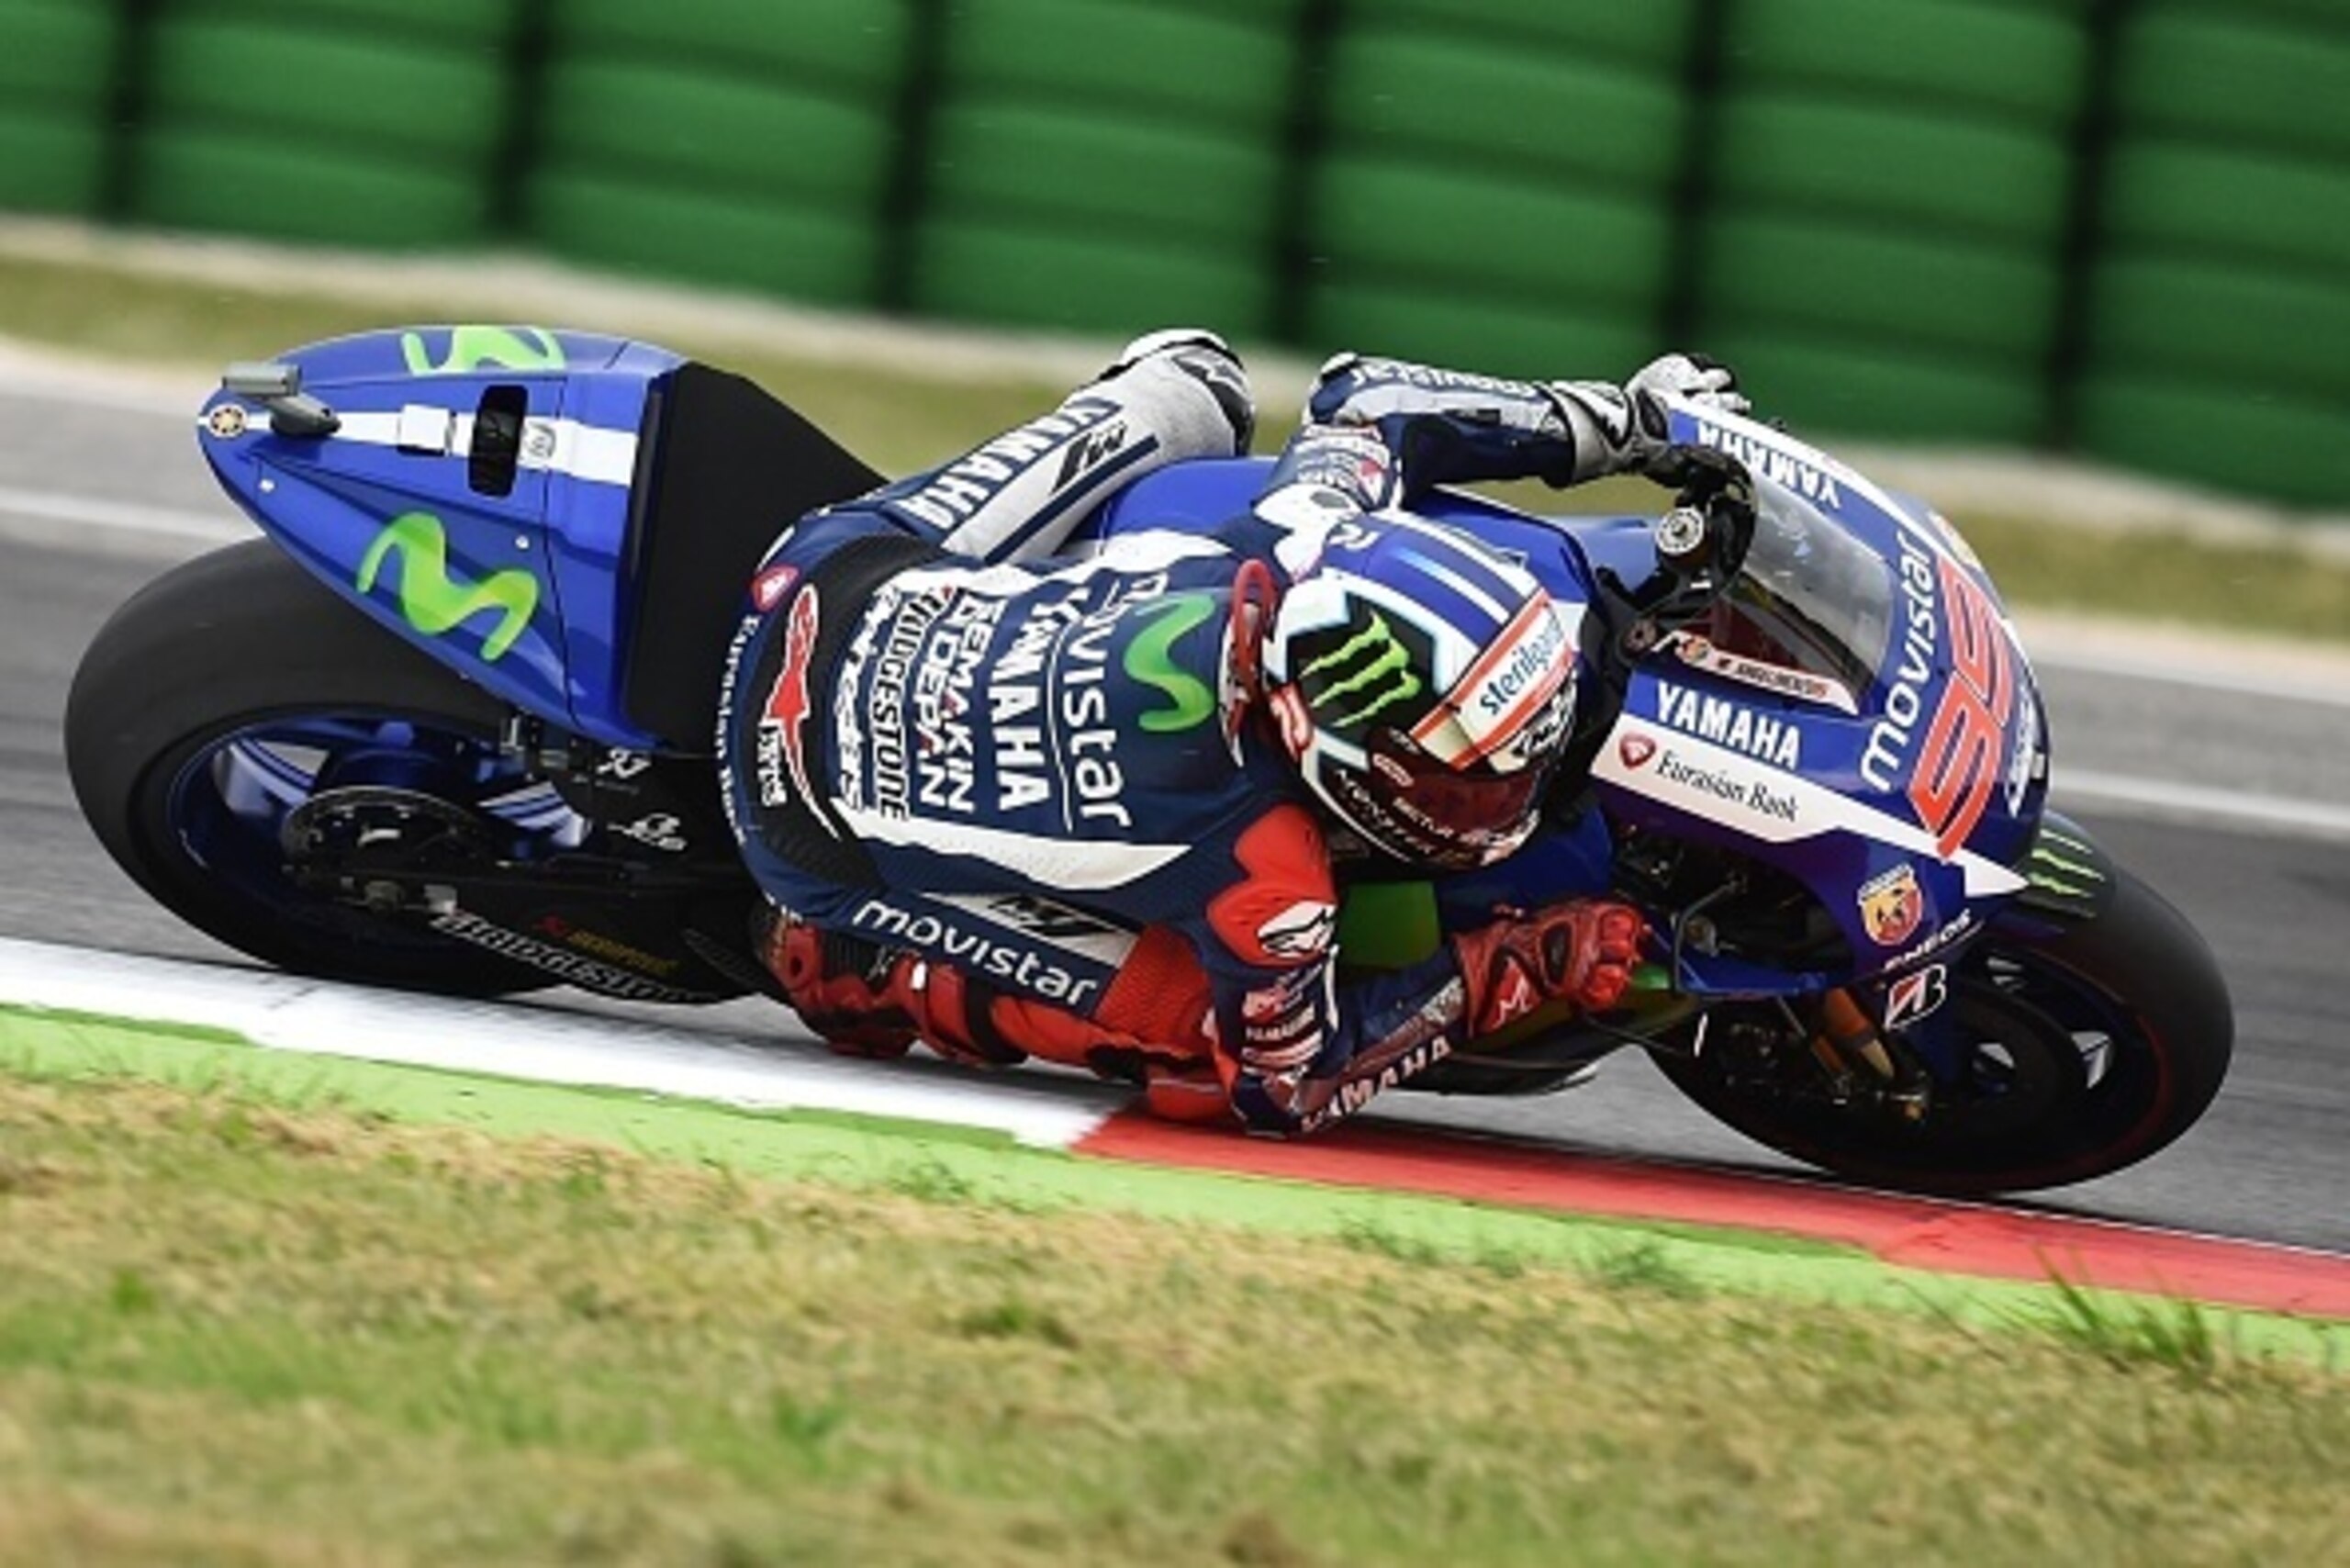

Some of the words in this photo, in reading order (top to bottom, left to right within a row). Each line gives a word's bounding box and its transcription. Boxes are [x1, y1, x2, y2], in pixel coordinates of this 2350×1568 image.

[895, 404, 1104, 531] YAMAHA
[1695, 420, 1841, 509] YAMAHA
[989, 586, 1091, 812] YAMAHA
[1860, 530, 1935, 792] movistar
[1907, 553, 2014, 859] 99
[1656, 681, 1801, 770] YAMAHA
[1654, 748, 1745, 804] Eurasian
[1747, 782, 1799, 824] Bank
[853, 900, 1101, 1005] movistar
